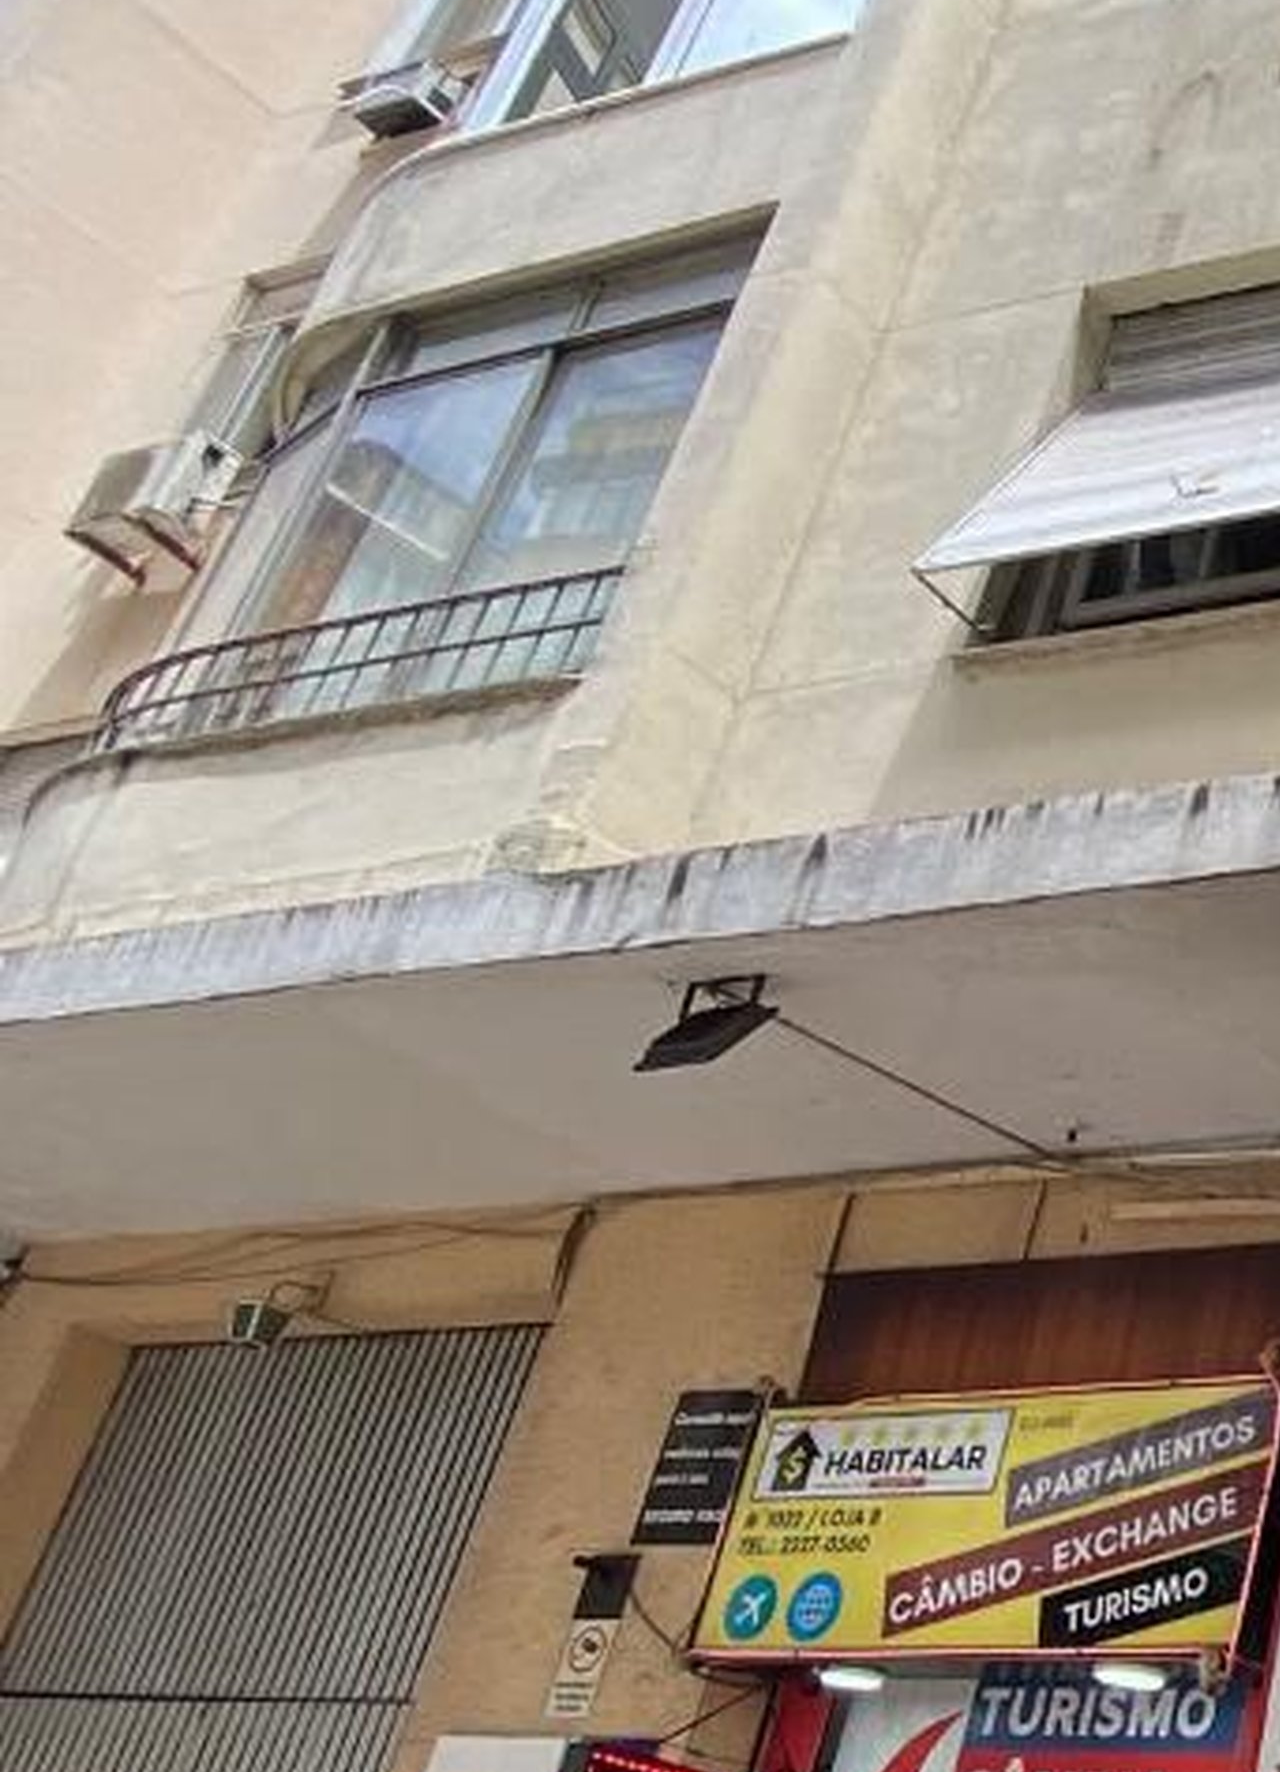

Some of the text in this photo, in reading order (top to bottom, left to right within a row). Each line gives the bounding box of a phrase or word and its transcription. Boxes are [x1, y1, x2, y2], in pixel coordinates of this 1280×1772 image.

[823, 1445, 987, 1476] HABITALAR
[1013, 1416, 1256, 1512] APARTAMENTOS
[889, 1557, 1024, 1624] CÂMBIO
[1052, 1487, 1240, 1574] EXCHANGE
[1063, 1568, 1209, 1631] TURISMO
[980, 1686, 1218, 1739] TURISMO
